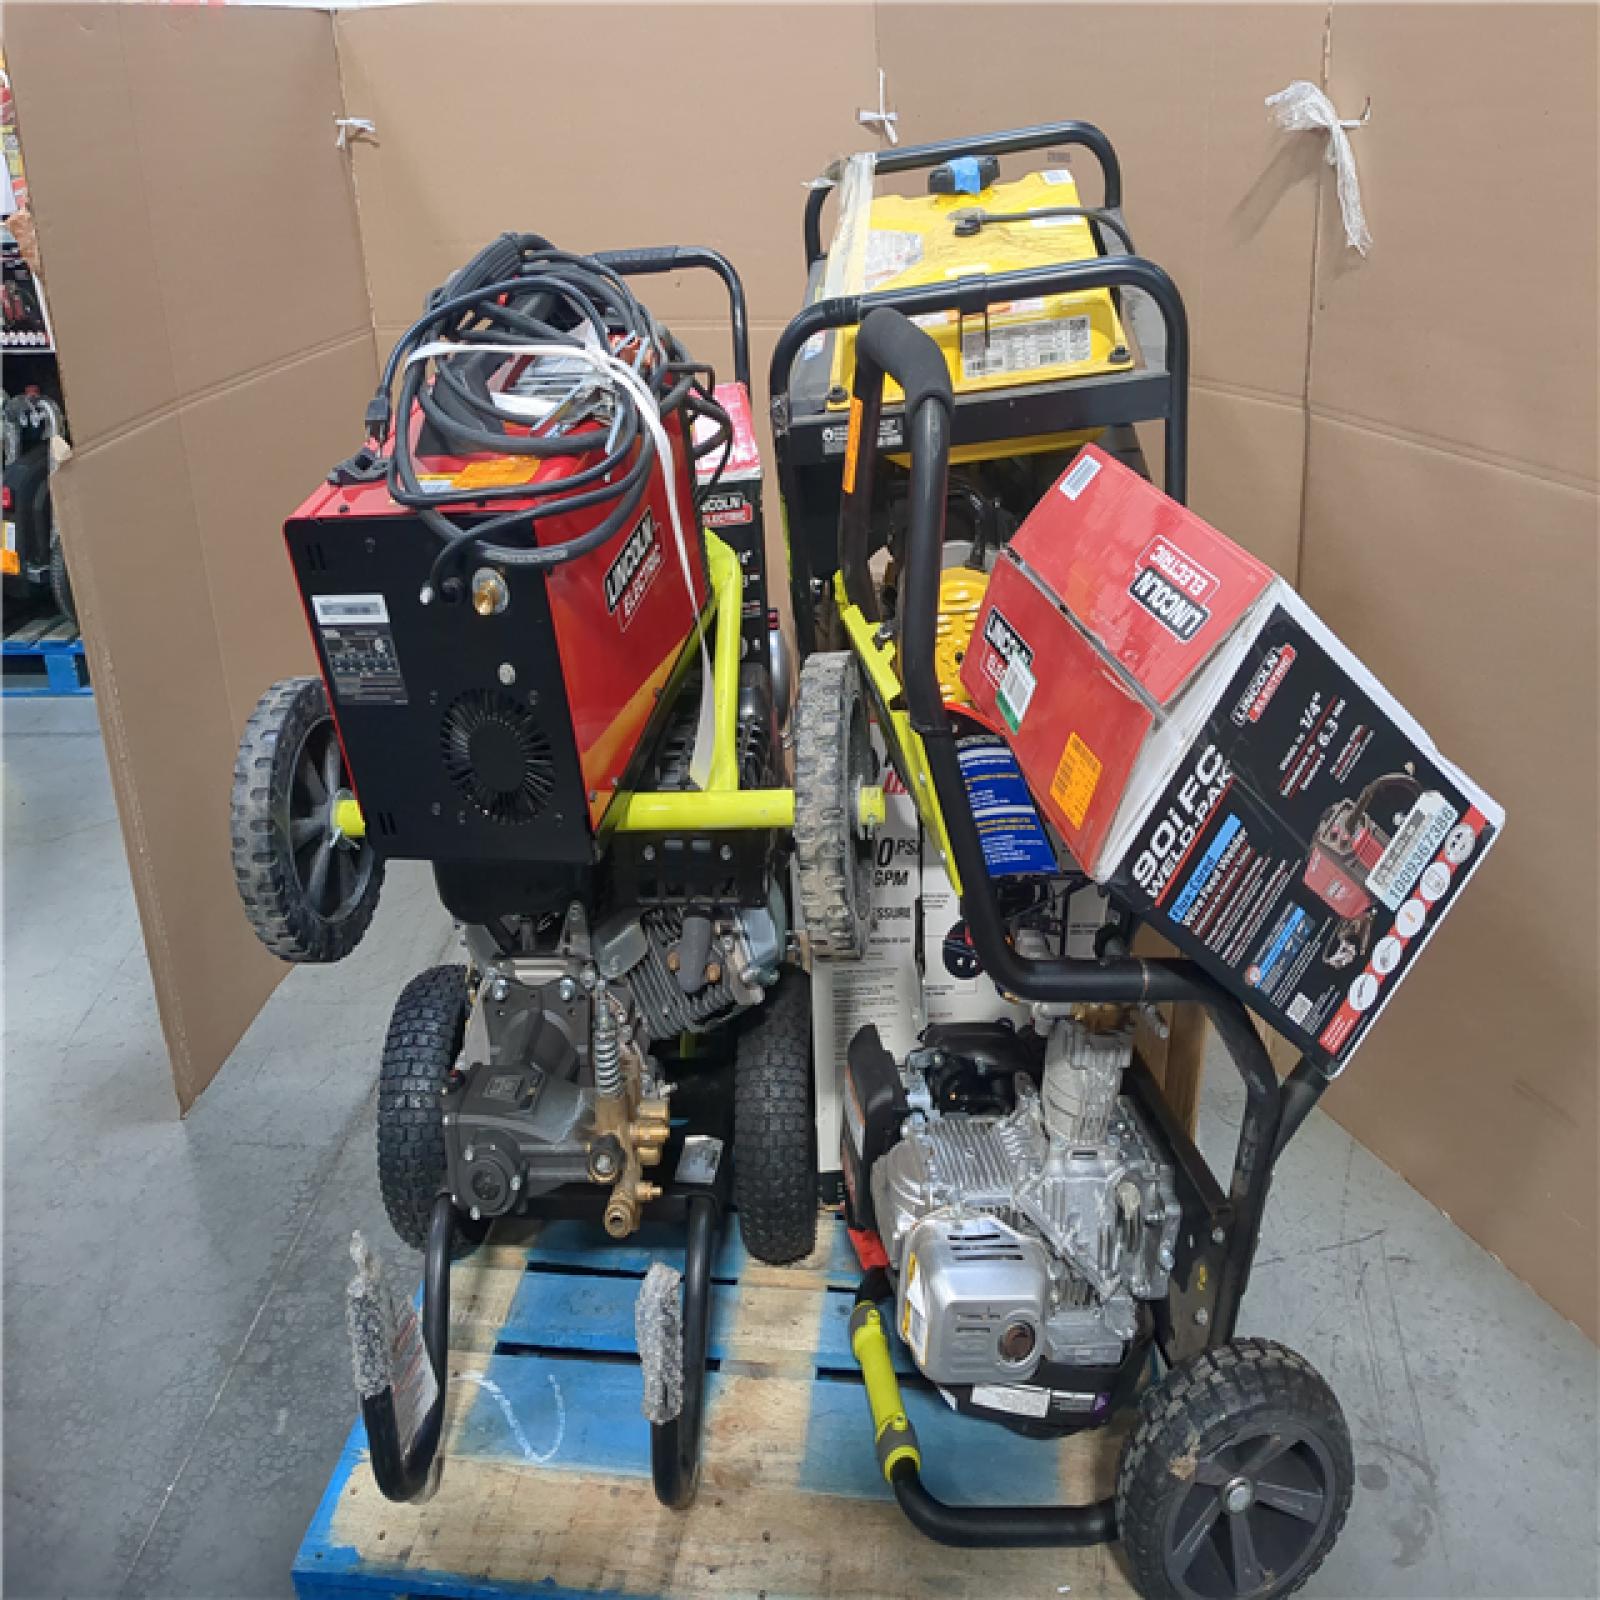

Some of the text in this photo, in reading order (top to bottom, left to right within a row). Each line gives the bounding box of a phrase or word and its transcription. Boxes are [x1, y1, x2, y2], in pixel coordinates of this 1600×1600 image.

[607, 518, 653, 604] LINCOLN
[624, 549, 660, 616] ELECTRIC
[1149, 545, 1209, 596] ELECTRIC
[1133, 571, 1201, 636] LINCOLN
[1234, 653, 1278, 720] LINCOLN
[1252, 654, 1292, 713] ELECTRIC
[1318, 718, 1339, 746] 6.3
[1132, 744, 1224, 889] 90i FC
[1145, 766, 1233, 899] WELD-PAK
[1182, 897, 1204, 928] Wire
[1198, 867, 1222, 900] Feed
